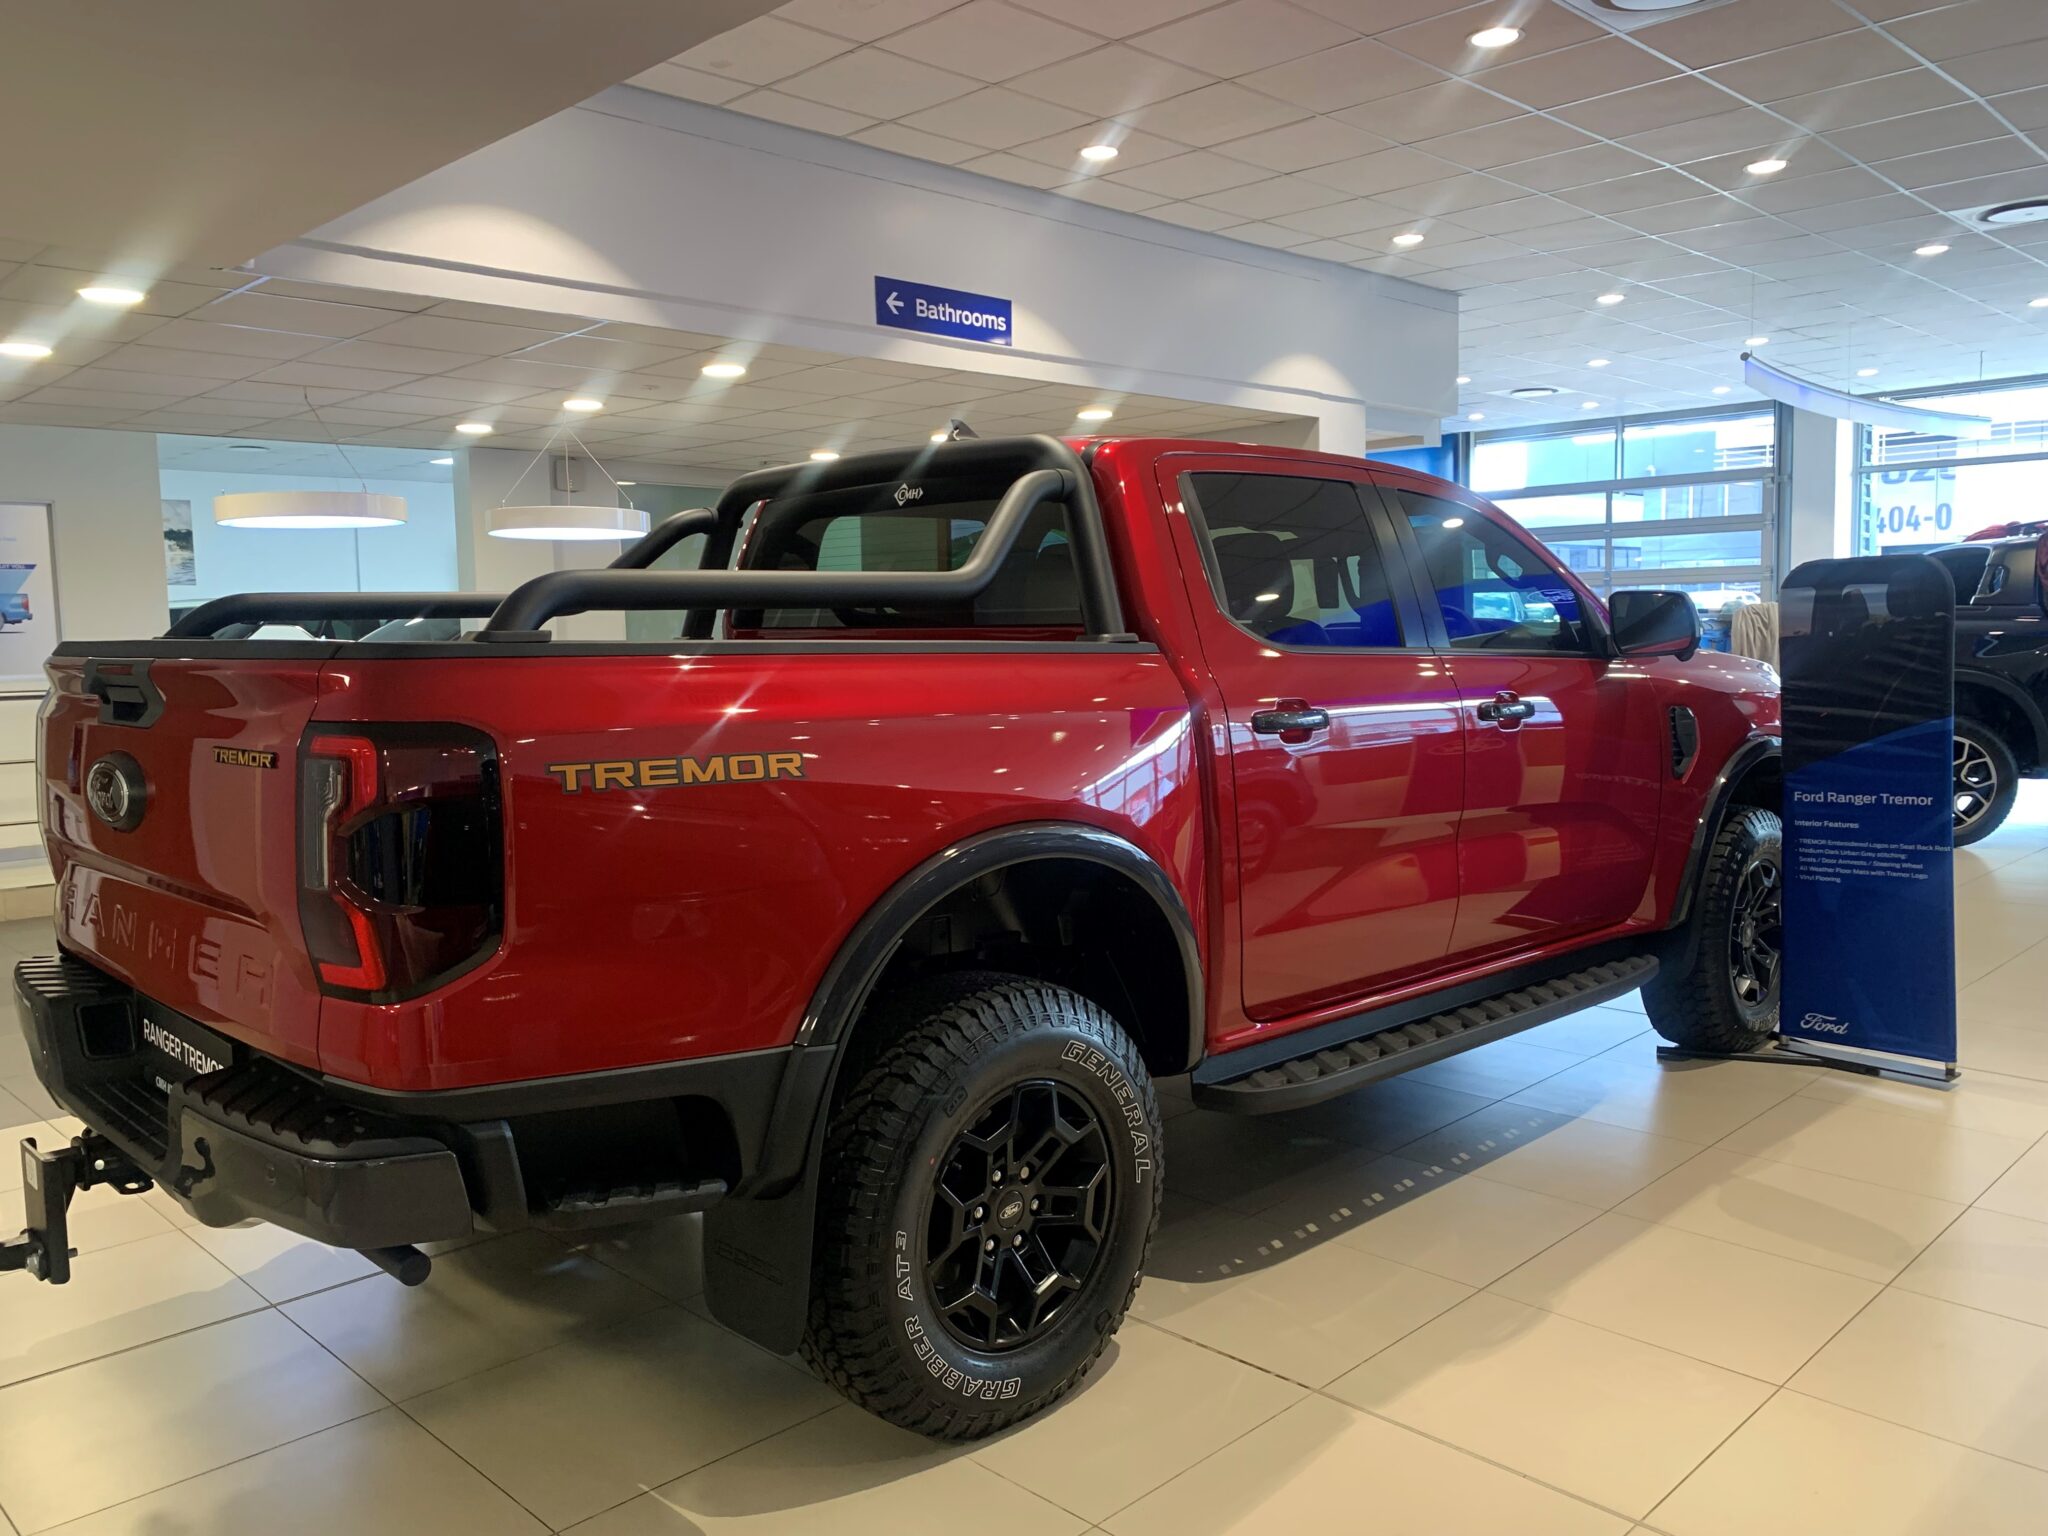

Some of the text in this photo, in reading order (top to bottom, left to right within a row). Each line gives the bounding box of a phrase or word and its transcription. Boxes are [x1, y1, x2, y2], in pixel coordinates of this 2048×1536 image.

[915, 298, 1007, 331] Bathrooms
[213, 748, 272, 768] TREMOR
[547, 751, 806, 793] TREMOR
[1794, 791, 1934, 806] Ford Ranger Tremor
[1794, 819, 1860, 829] Interior Features
[1800, 1012, 1850, 1035] Ford
[143, 1018, 224, 1075] RANGER TREMO
[1060, 1039, 1152, 1184] GENERAL
[903, 1314, 1023, 1401] GRABBER
